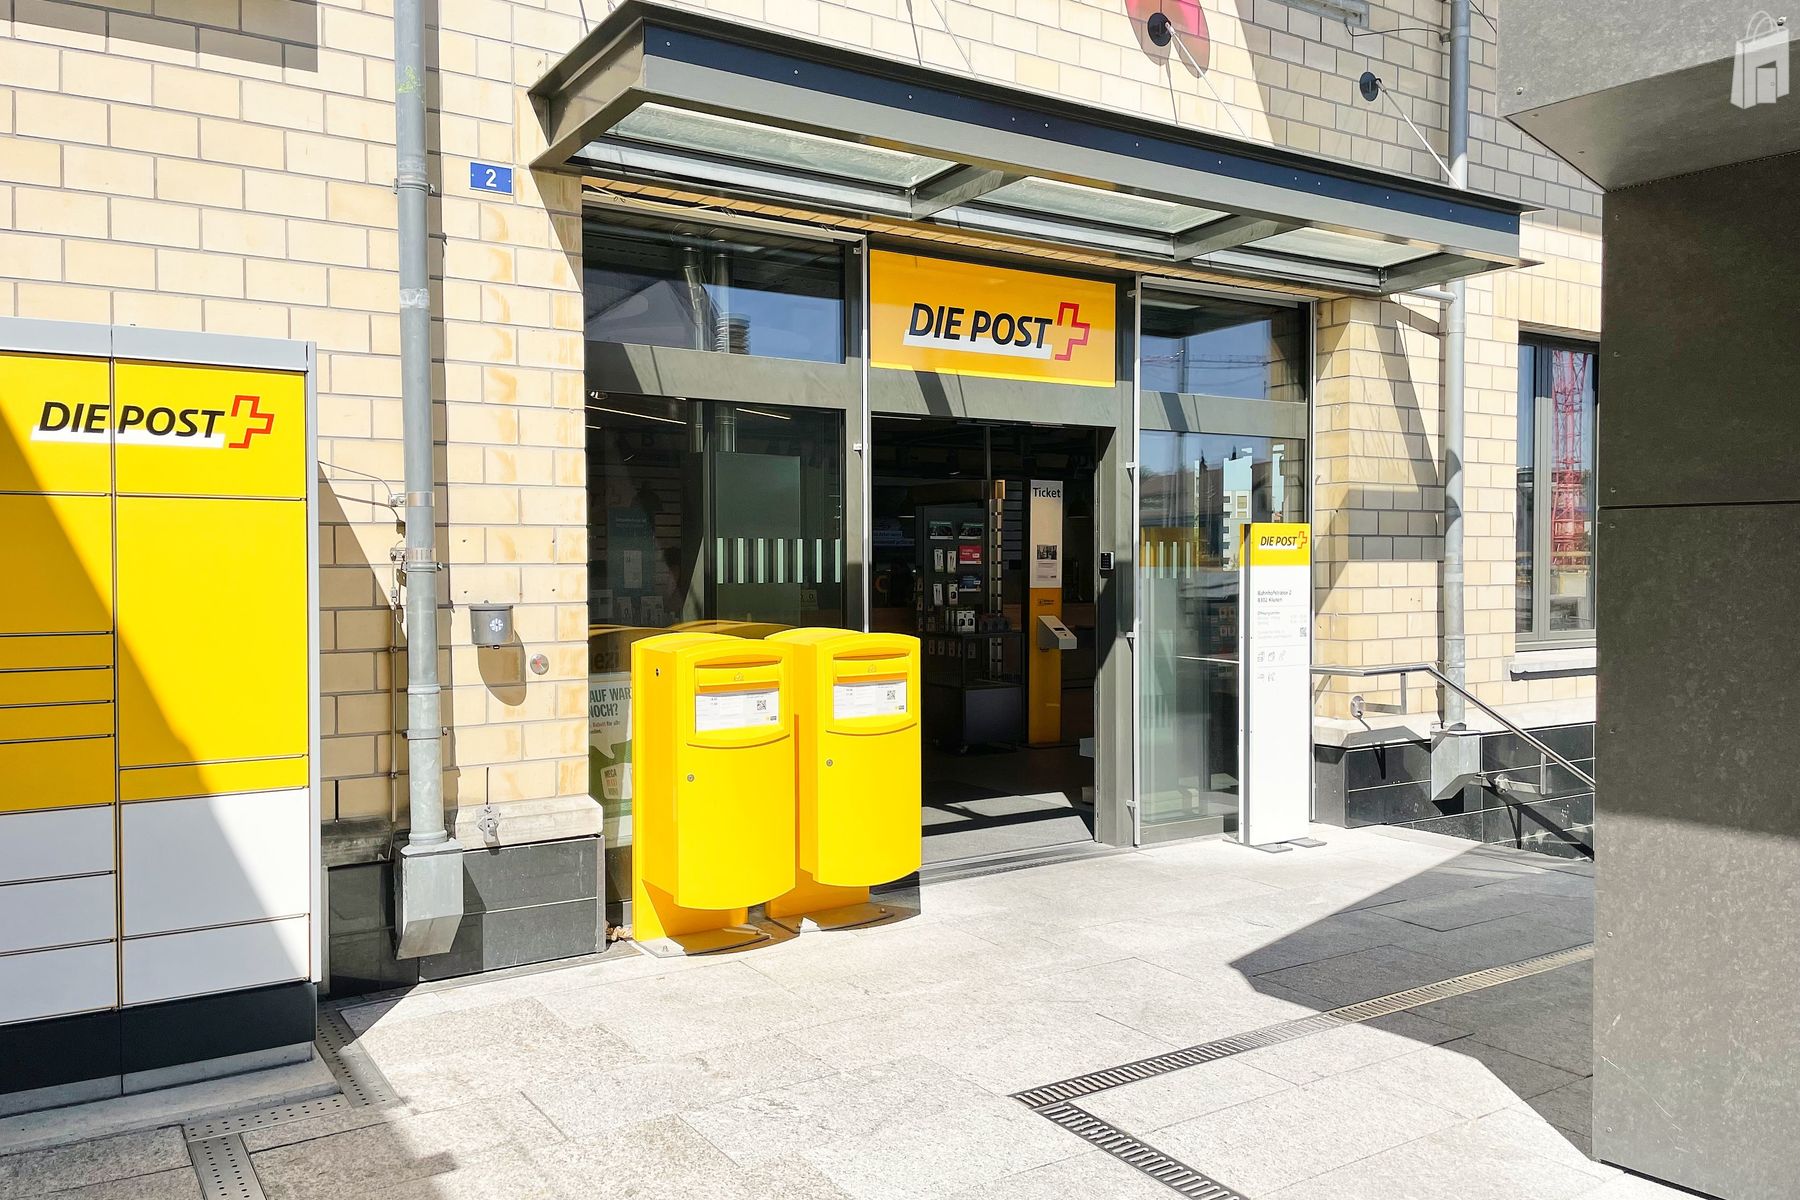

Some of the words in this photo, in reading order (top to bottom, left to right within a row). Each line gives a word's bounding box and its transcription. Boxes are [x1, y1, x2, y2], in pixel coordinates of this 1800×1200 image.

[485, 168, 497, 188] 2
[908, 302, 965, 341] DIE
[969, 309, 1053, 349] POST
[38, 401, 110, 434] DIE
[117, 404, 226, 438] POST
[1033, 486, 1061, 498] Ticket
[1260, 536, 1275, 547] DIE
[1275, 536, 1298, 547] POST
[589, 689, 607, 703] AUF
[608, 687, 632, 701] WAR
